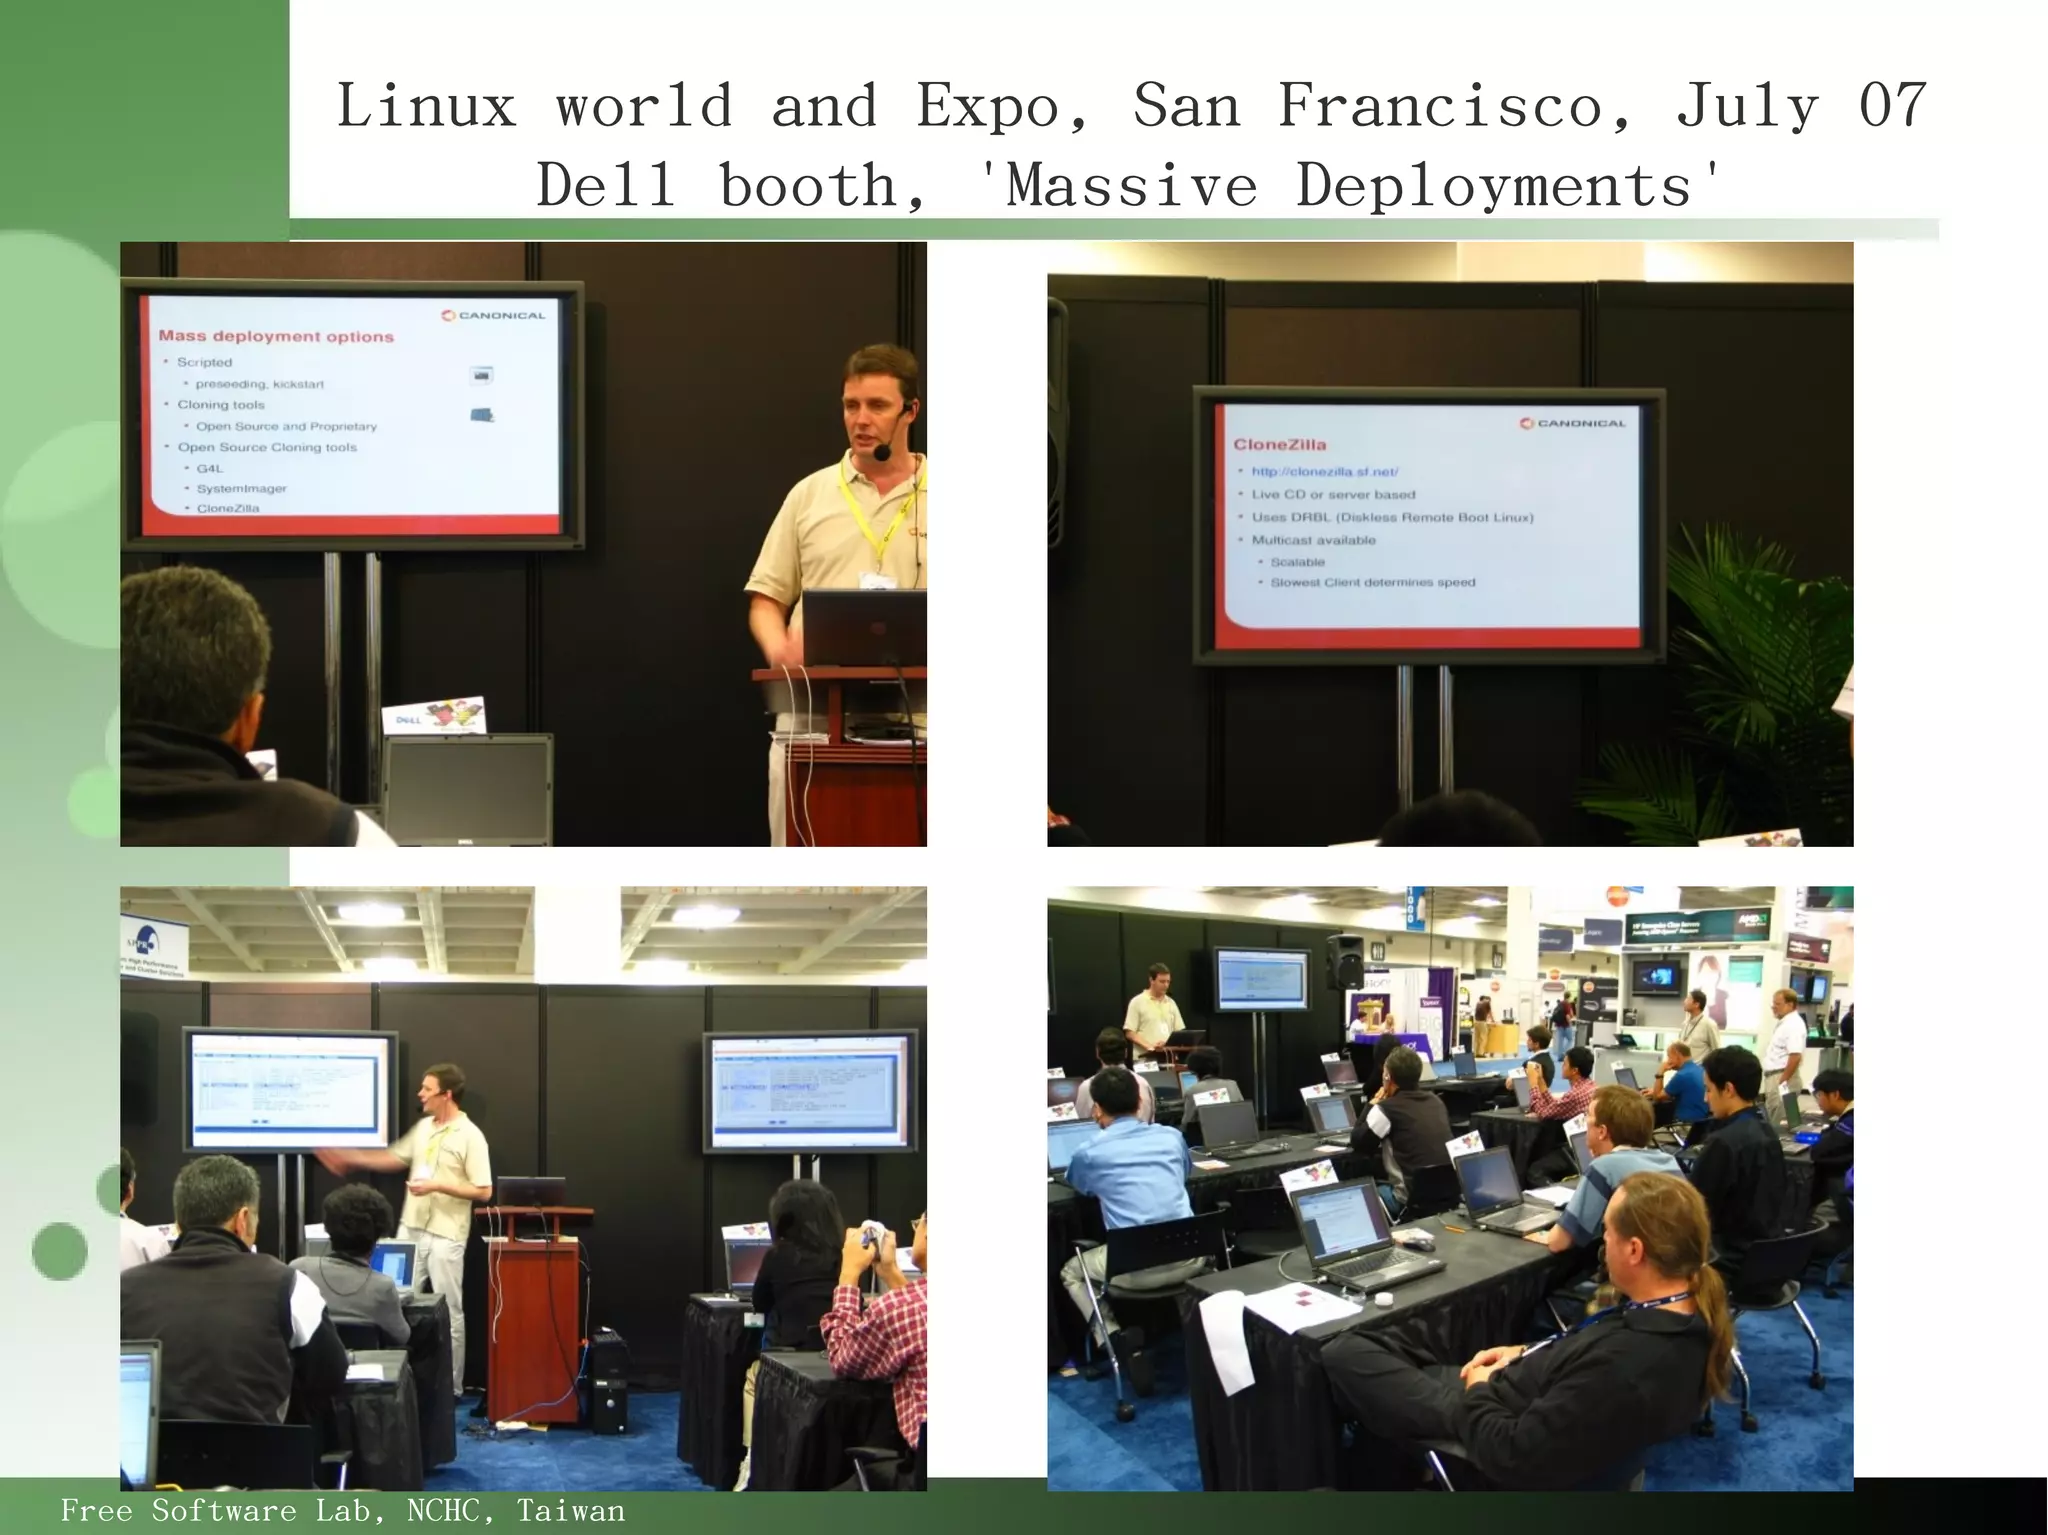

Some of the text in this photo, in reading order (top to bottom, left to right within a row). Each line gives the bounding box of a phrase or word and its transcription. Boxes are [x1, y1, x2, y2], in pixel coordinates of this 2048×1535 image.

[459, 311, 546, 320] CANONICAL
[158, 329, 395, 346] Mass deployment options
[177, 356, 233, 369] Scripted
[195, 379, 324, 392] preseeding, kickstart
[177, 399, 265, 412] Cloning tools
[196, 421, 378, 433] Open Source and Proprietary
[1537, 419, 1626, 428] CANONICAL
[177, 441, 358, 455] Open Source Cloning tools
[1233, 438, 1327, 451] CloneZilla
[196, 464, 223, 474] G4L
[196, 484, 287, 496] SystemImager
[1252, 489, 1417, 500] Live CD or server based
[196, 503, 260, 514] CloneZilla
[1252, 511, 1534, 525] Uses DRBL (Diskless Remote Boot Linux)
[1251, 534, 1377, 546] Multicast available
[1271, 557, 1326, 568] Scalable
[1270, 577, 1476, 589] Slowest Client determines speed
